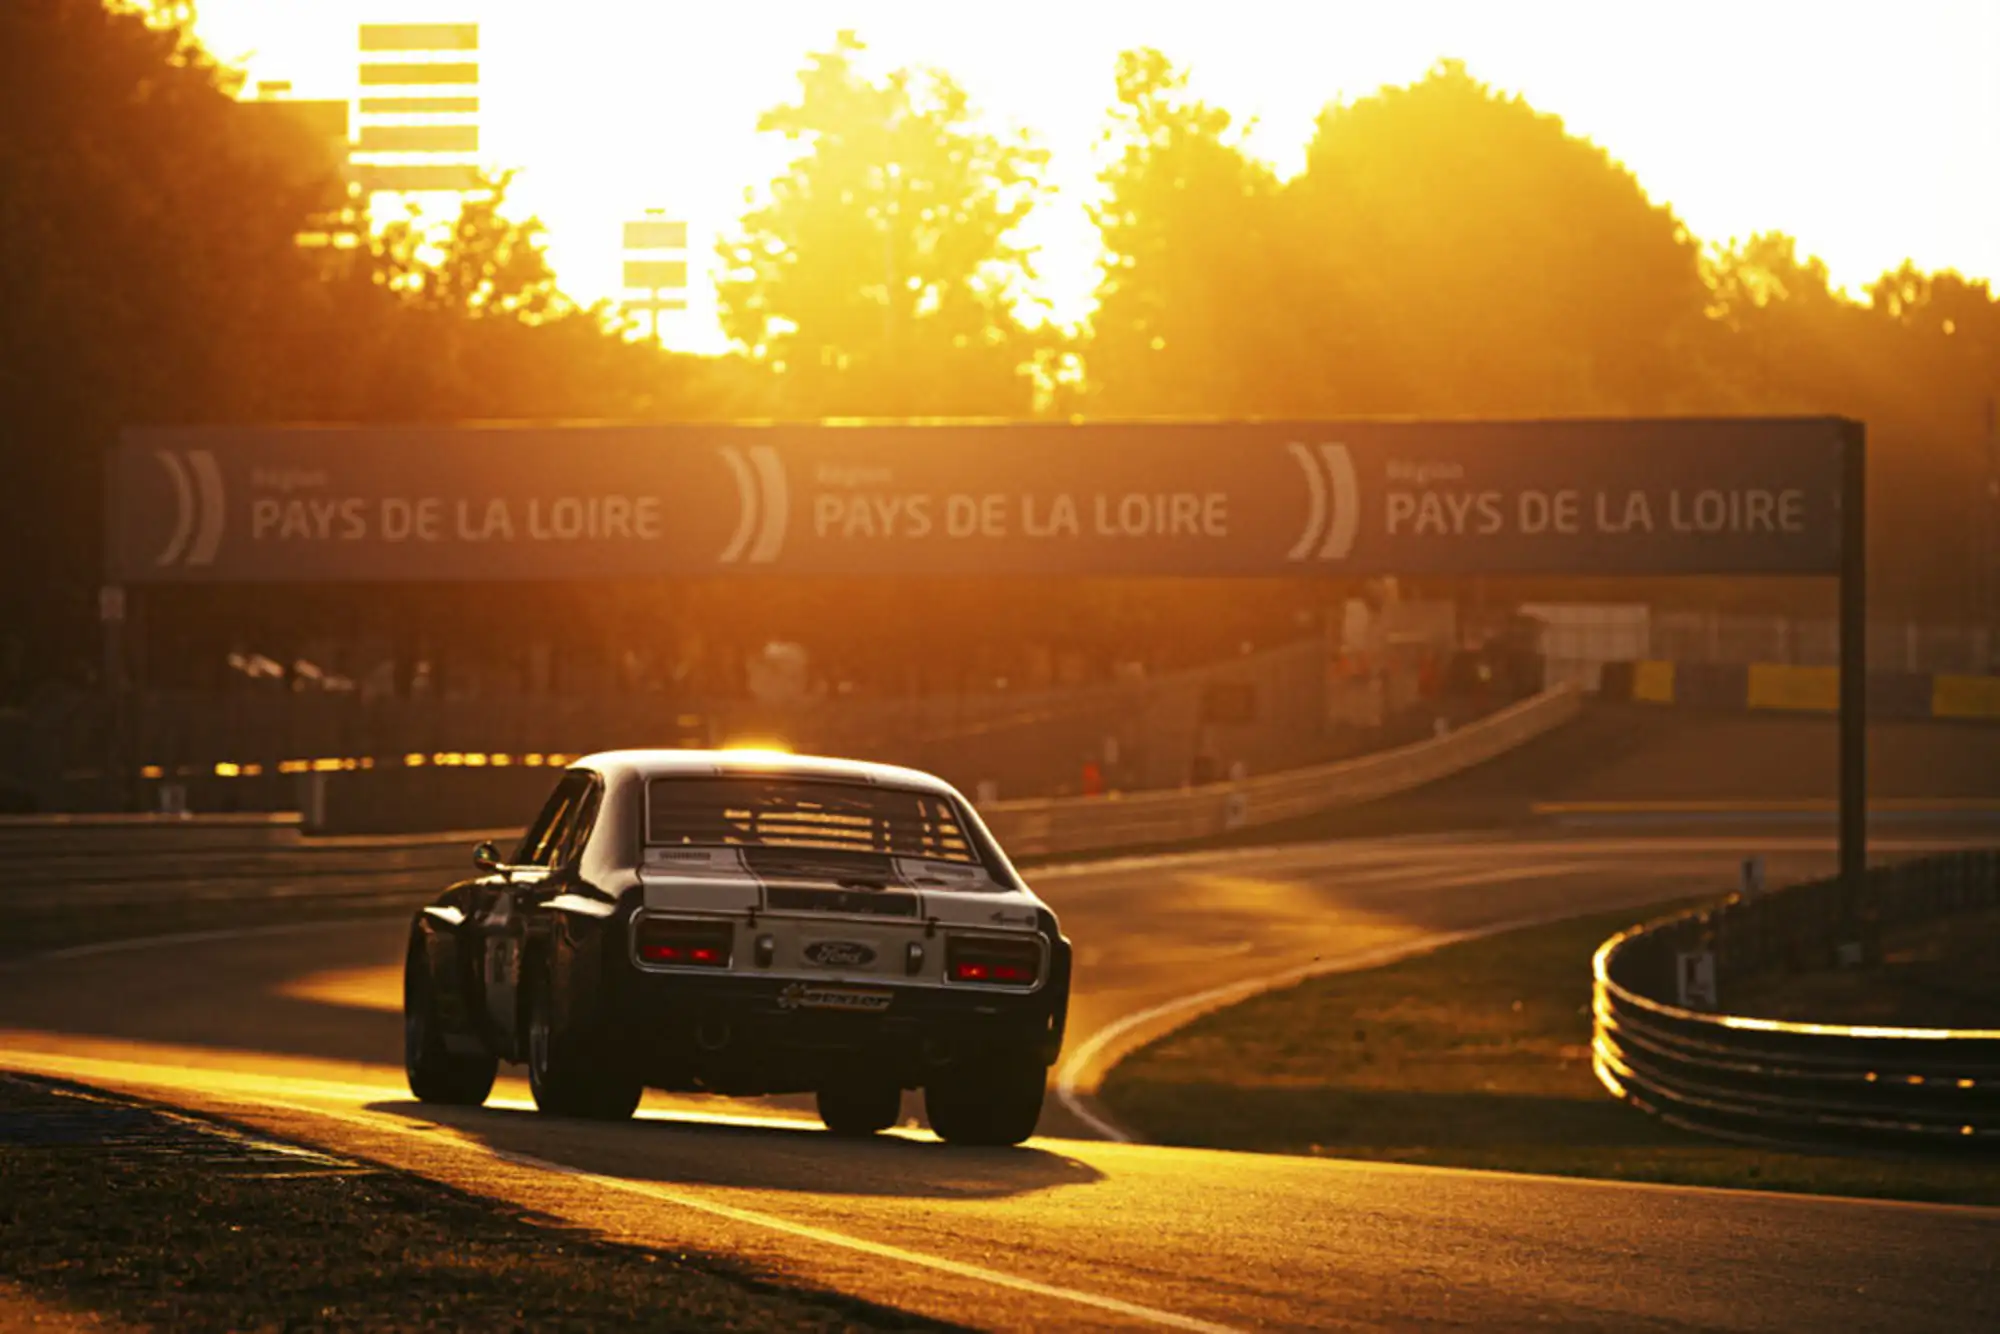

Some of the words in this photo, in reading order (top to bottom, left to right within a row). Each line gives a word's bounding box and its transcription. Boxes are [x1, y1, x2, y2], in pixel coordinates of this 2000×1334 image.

[252, 497, 366, 540] PAYS
[381, 497, 443, 541] DE
[456, 497, 514, 541] LA
[529, 495, 662, 540] LOIRE
[813, 493, 932, 537] PAYS
[946, 493, 1007, 537] DE
[1021, 493, 1079, 537] LA
[1094, 493, 1227, 537] LOIRE
[1386, 491, 1503, 534] PAYS
[1518, 490, 1580, 534] DE
[1595, 490, 1653, 534] LA
[1670, 490, 1804, 533] LOIRE
[817, 943, 863, 965] Ford
